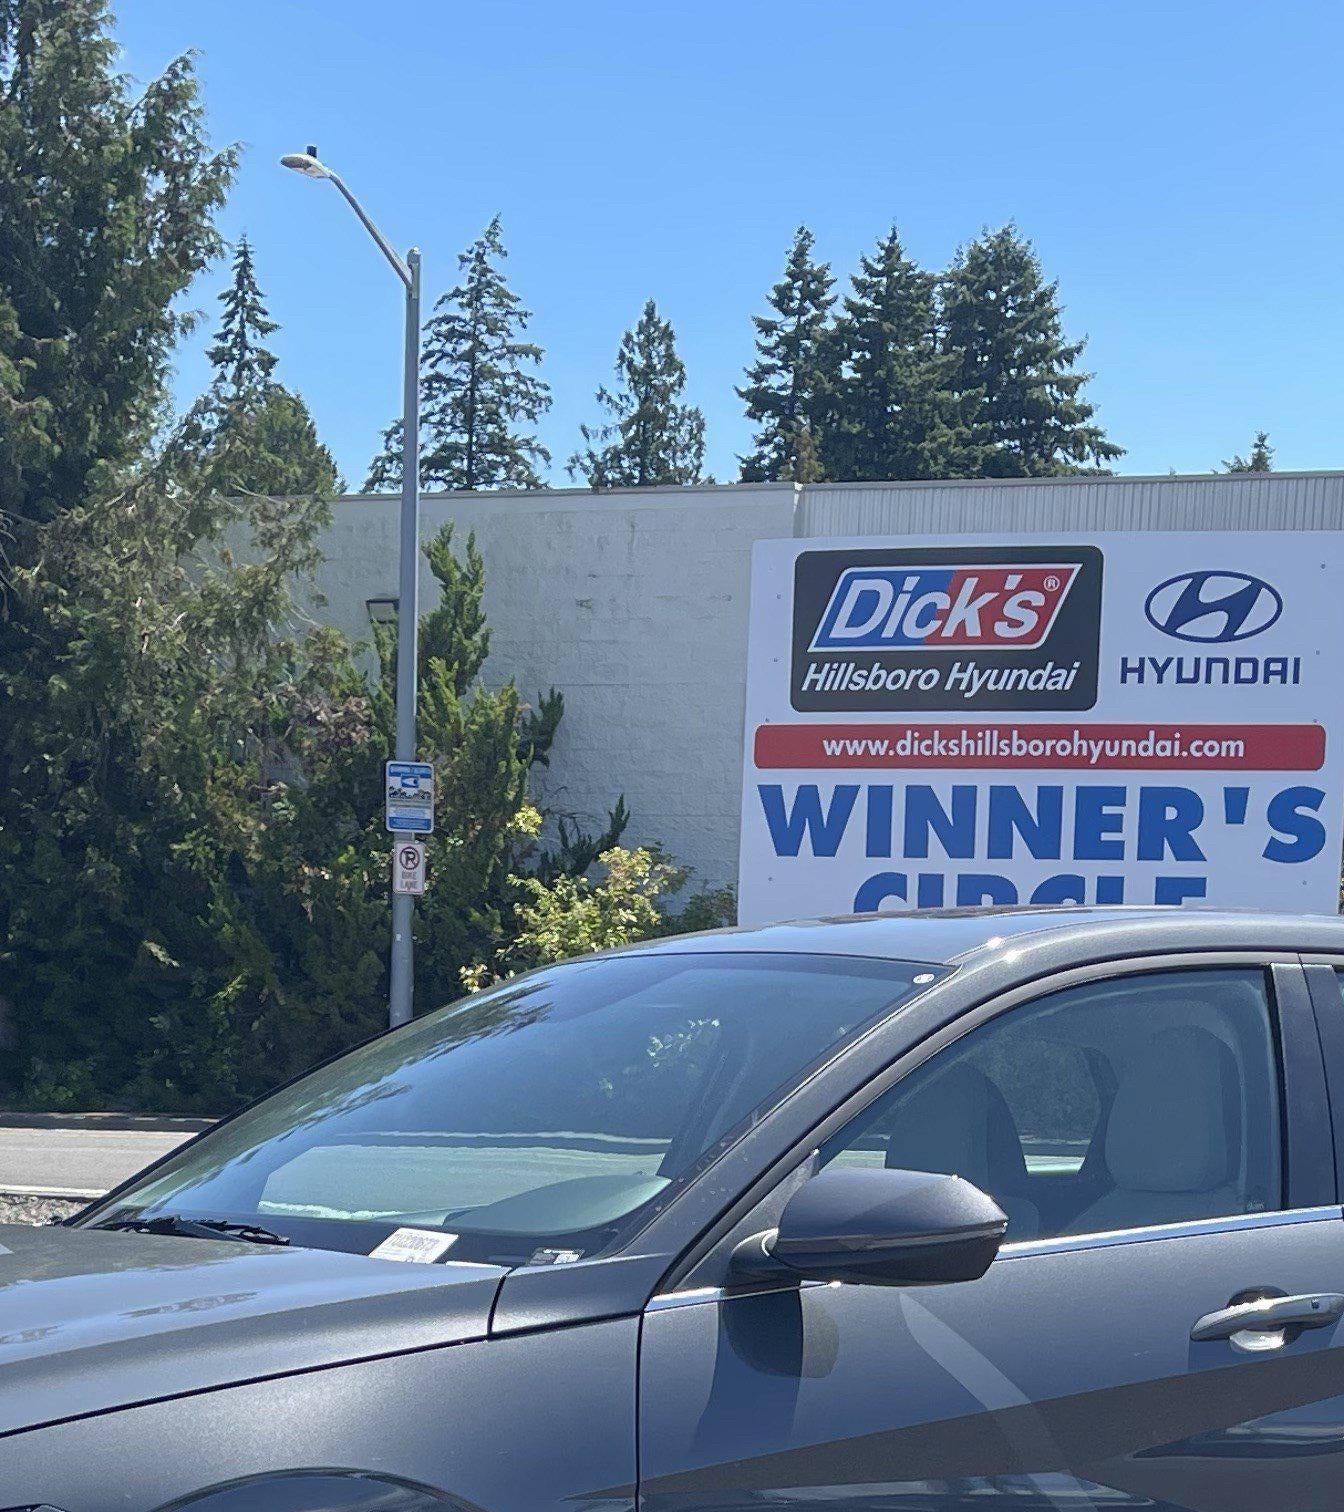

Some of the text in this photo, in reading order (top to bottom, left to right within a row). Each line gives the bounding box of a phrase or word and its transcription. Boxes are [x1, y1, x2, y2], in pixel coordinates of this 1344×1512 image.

[828, 574, 1046, 640] Dick's
[801, 661, 1081, 698] Hillsboro Hyundai
[1119, 656, 1302, 685] HYUNDAI
[822, 729, 1245, 767] www.dickshillsborohyundai.com
[756, 784, 1327, 864] WINNER'S
